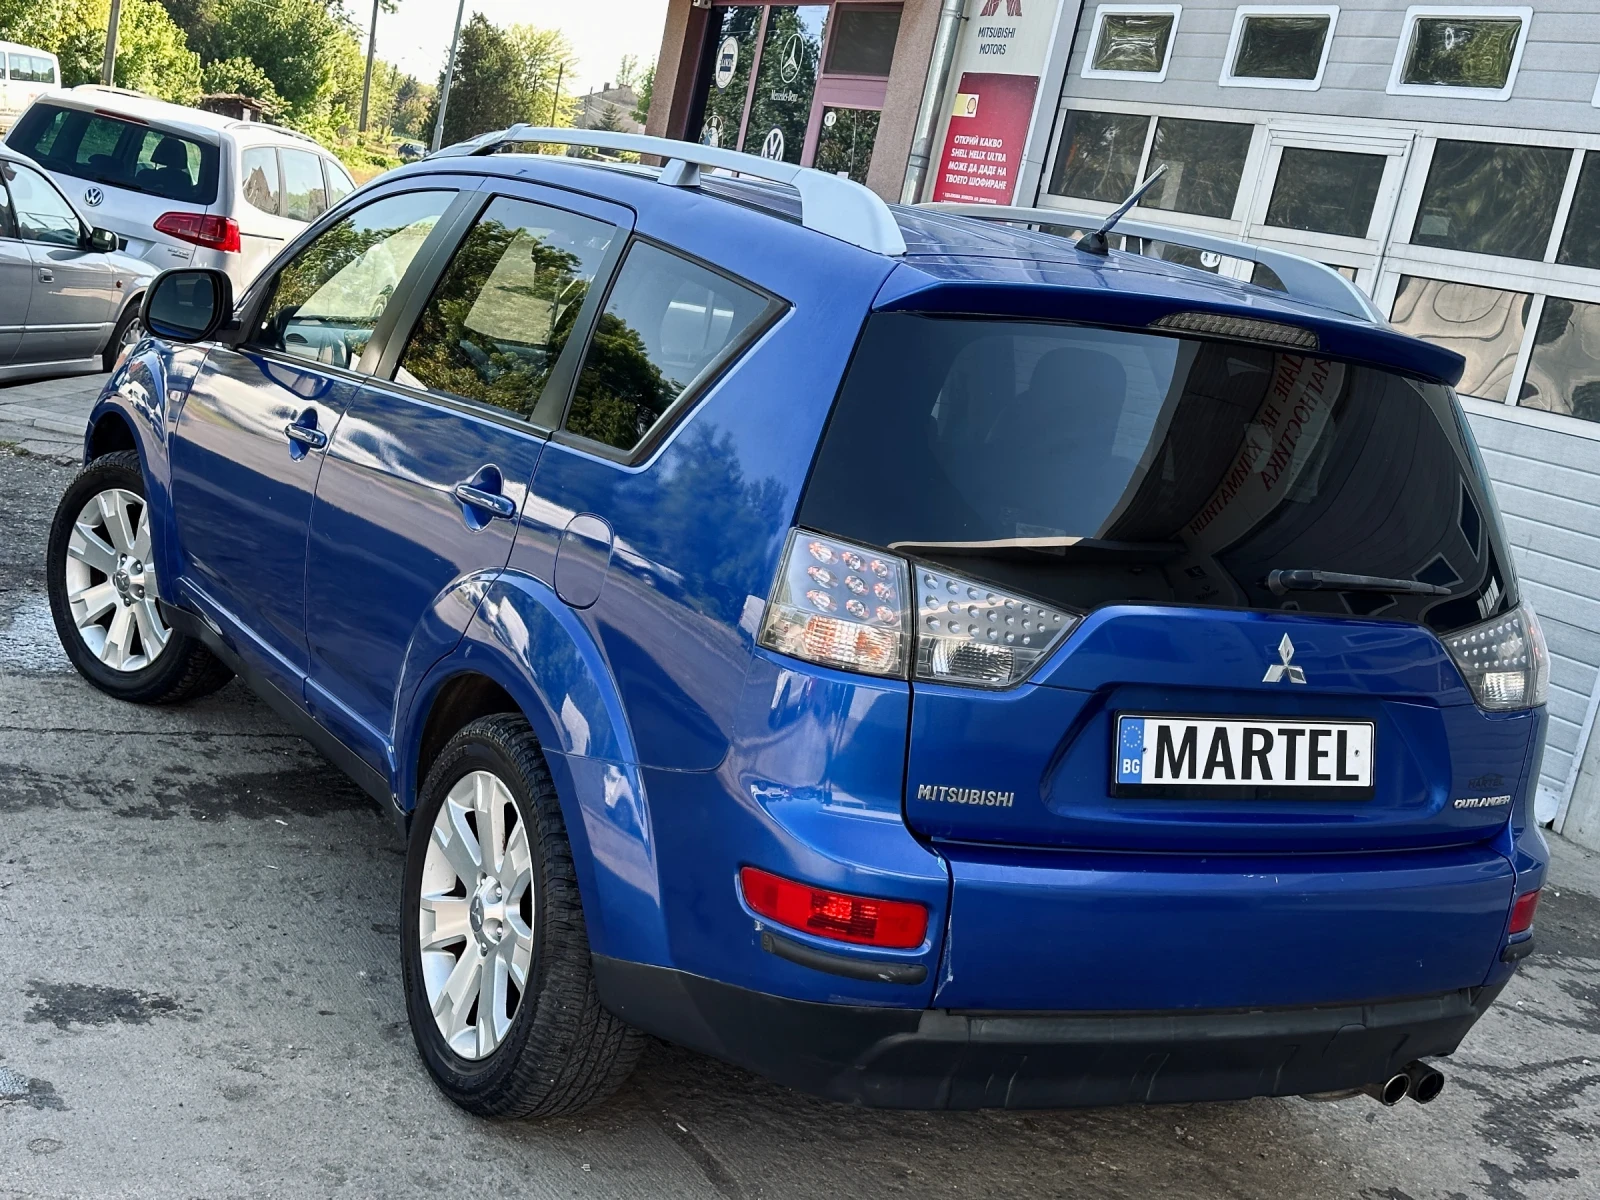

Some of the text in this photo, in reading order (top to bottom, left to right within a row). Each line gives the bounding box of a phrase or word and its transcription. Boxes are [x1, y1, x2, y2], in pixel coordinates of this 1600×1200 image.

[978, 27, 1016, 38] MITSUBISHI
[979, 44, 1007, 55] MOTORS
[954, 135, 1003, 148] ОТКРИЙ КАКВО
[951, 148, 1007, 162] SHELL HELIX ULTRA
[948, 161, 1007, 176] МОЖЕ ДА ДАДЕ НА
[945, 174, 1007, 190] ТВОЕТО ШОФИРАНЕ
[1122, 725, 1360, 781] BG MARTEL
[917, 784, 1015, 807] MITSUBISHI
[1453, 795, 1511, 809] OUTLANDER
